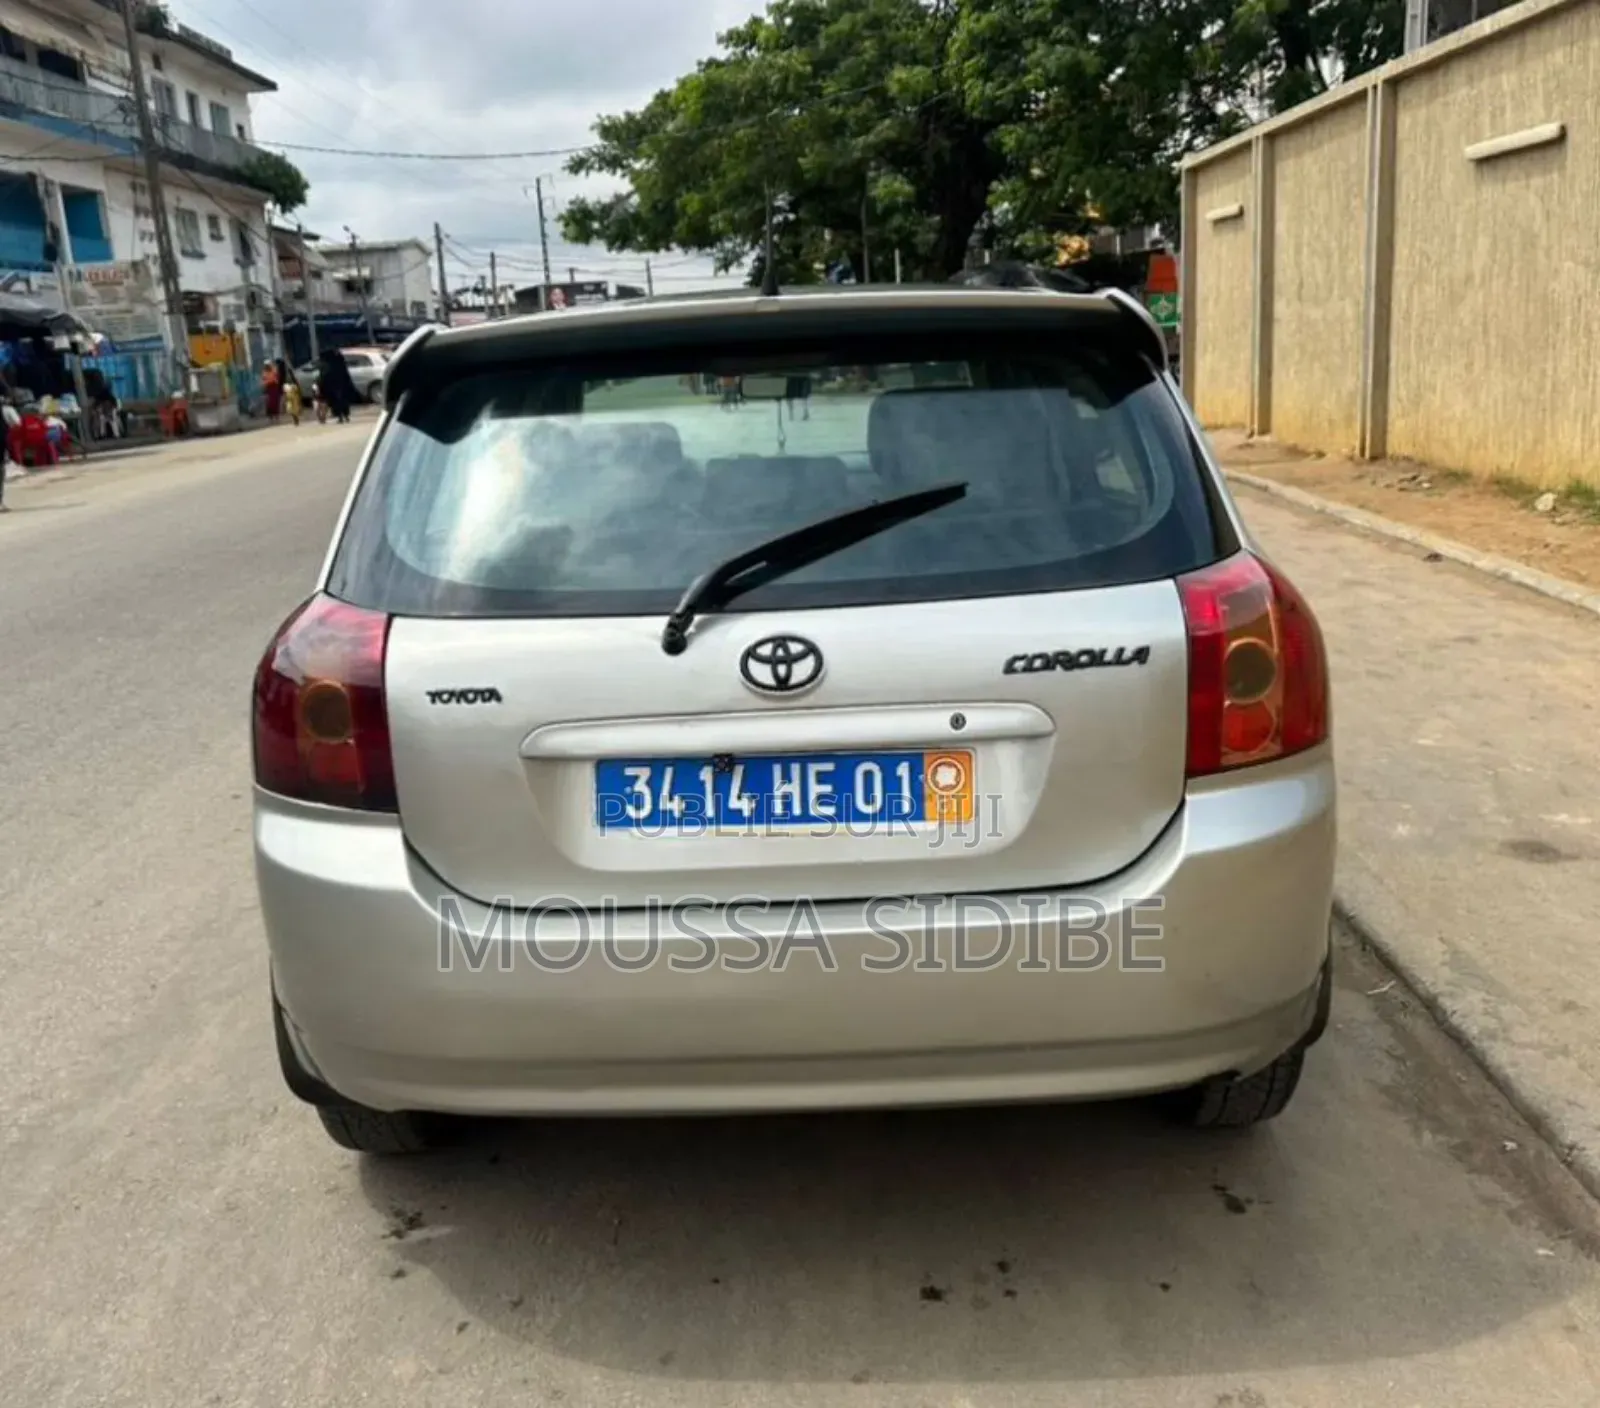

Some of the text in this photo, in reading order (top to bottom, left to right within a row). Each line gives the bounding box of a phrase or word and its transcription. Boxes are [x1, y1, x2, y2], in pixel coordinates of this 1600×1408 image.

[1003, 645, 1150, 674] COROLLA
[426, 688, 502, 704] TOYOTA
[624, 761, 911, 819] 3414 HE 01
